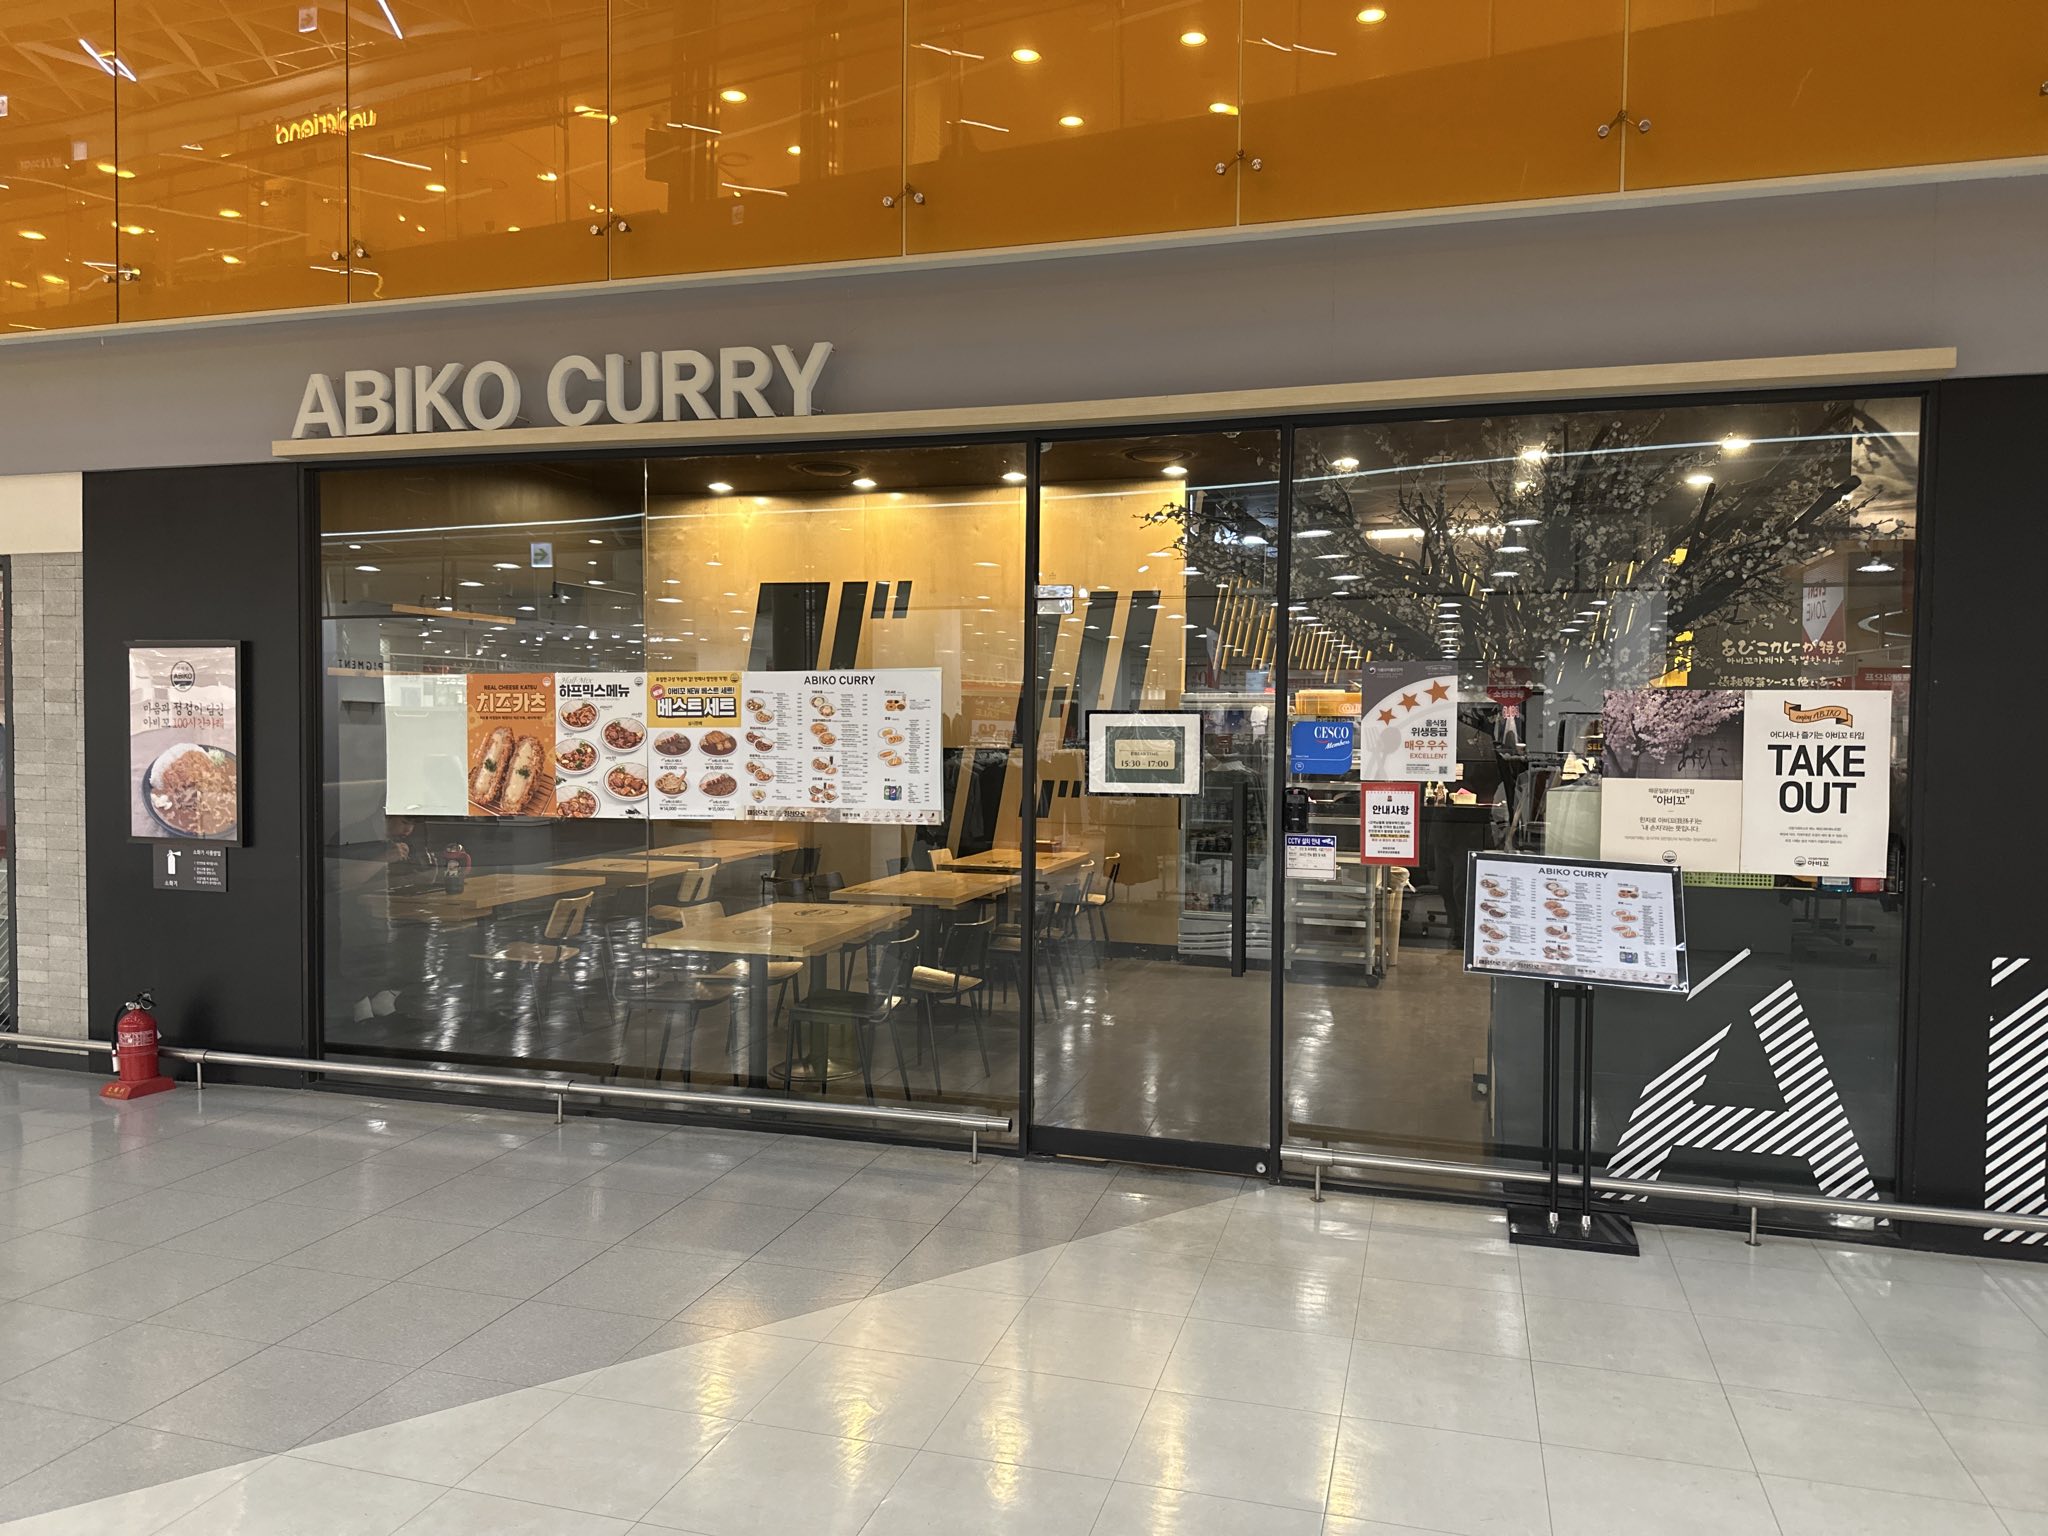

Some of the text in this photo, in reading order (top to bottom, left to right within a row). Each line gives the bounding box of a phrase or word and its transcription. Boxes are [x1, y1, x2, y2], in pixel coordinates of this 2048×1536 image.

[291, 342, 833, 439] ABIKO CURRY
[804, 675, 876, 685] ABIKO CURRY
[559, 684, 630, 698] 하프믹스메뉴
[667, 687, 686, 695] 아비꼬
[686, 687, 700, 695] NEW
[700, 687, 719, 695] 베스트
[143, 702, 170, 715] 마음과
[173, 701, 203, 716] 정성이
[476, 692, 546, 713] 치즈카츠
[656, 697, 736, 718] 베스트 세트
[143, 716, 171, 728] 아비꼬
[1426, 719, 1447, 727] 음식점
[1314, 726, 1349, 739] CESCO
[1411, 727, 1448, 737] 위생등급
[1770, 731, 1865, 740] 어디서나 즐기는 아비꼬 타임
[1404, 740, 1448, 751] 매우 우수
[1148, 760, 1169, 768] 17:00
[1767, 744, 1866, 777] TAKE
[1779, 782, 1857, 814] OUT
[1372, 805, 1410, 815] 안내사항
[1311, 838, 1321, 846] 안내
[1538, 867, 1608, 879] ABIKO CURRY
